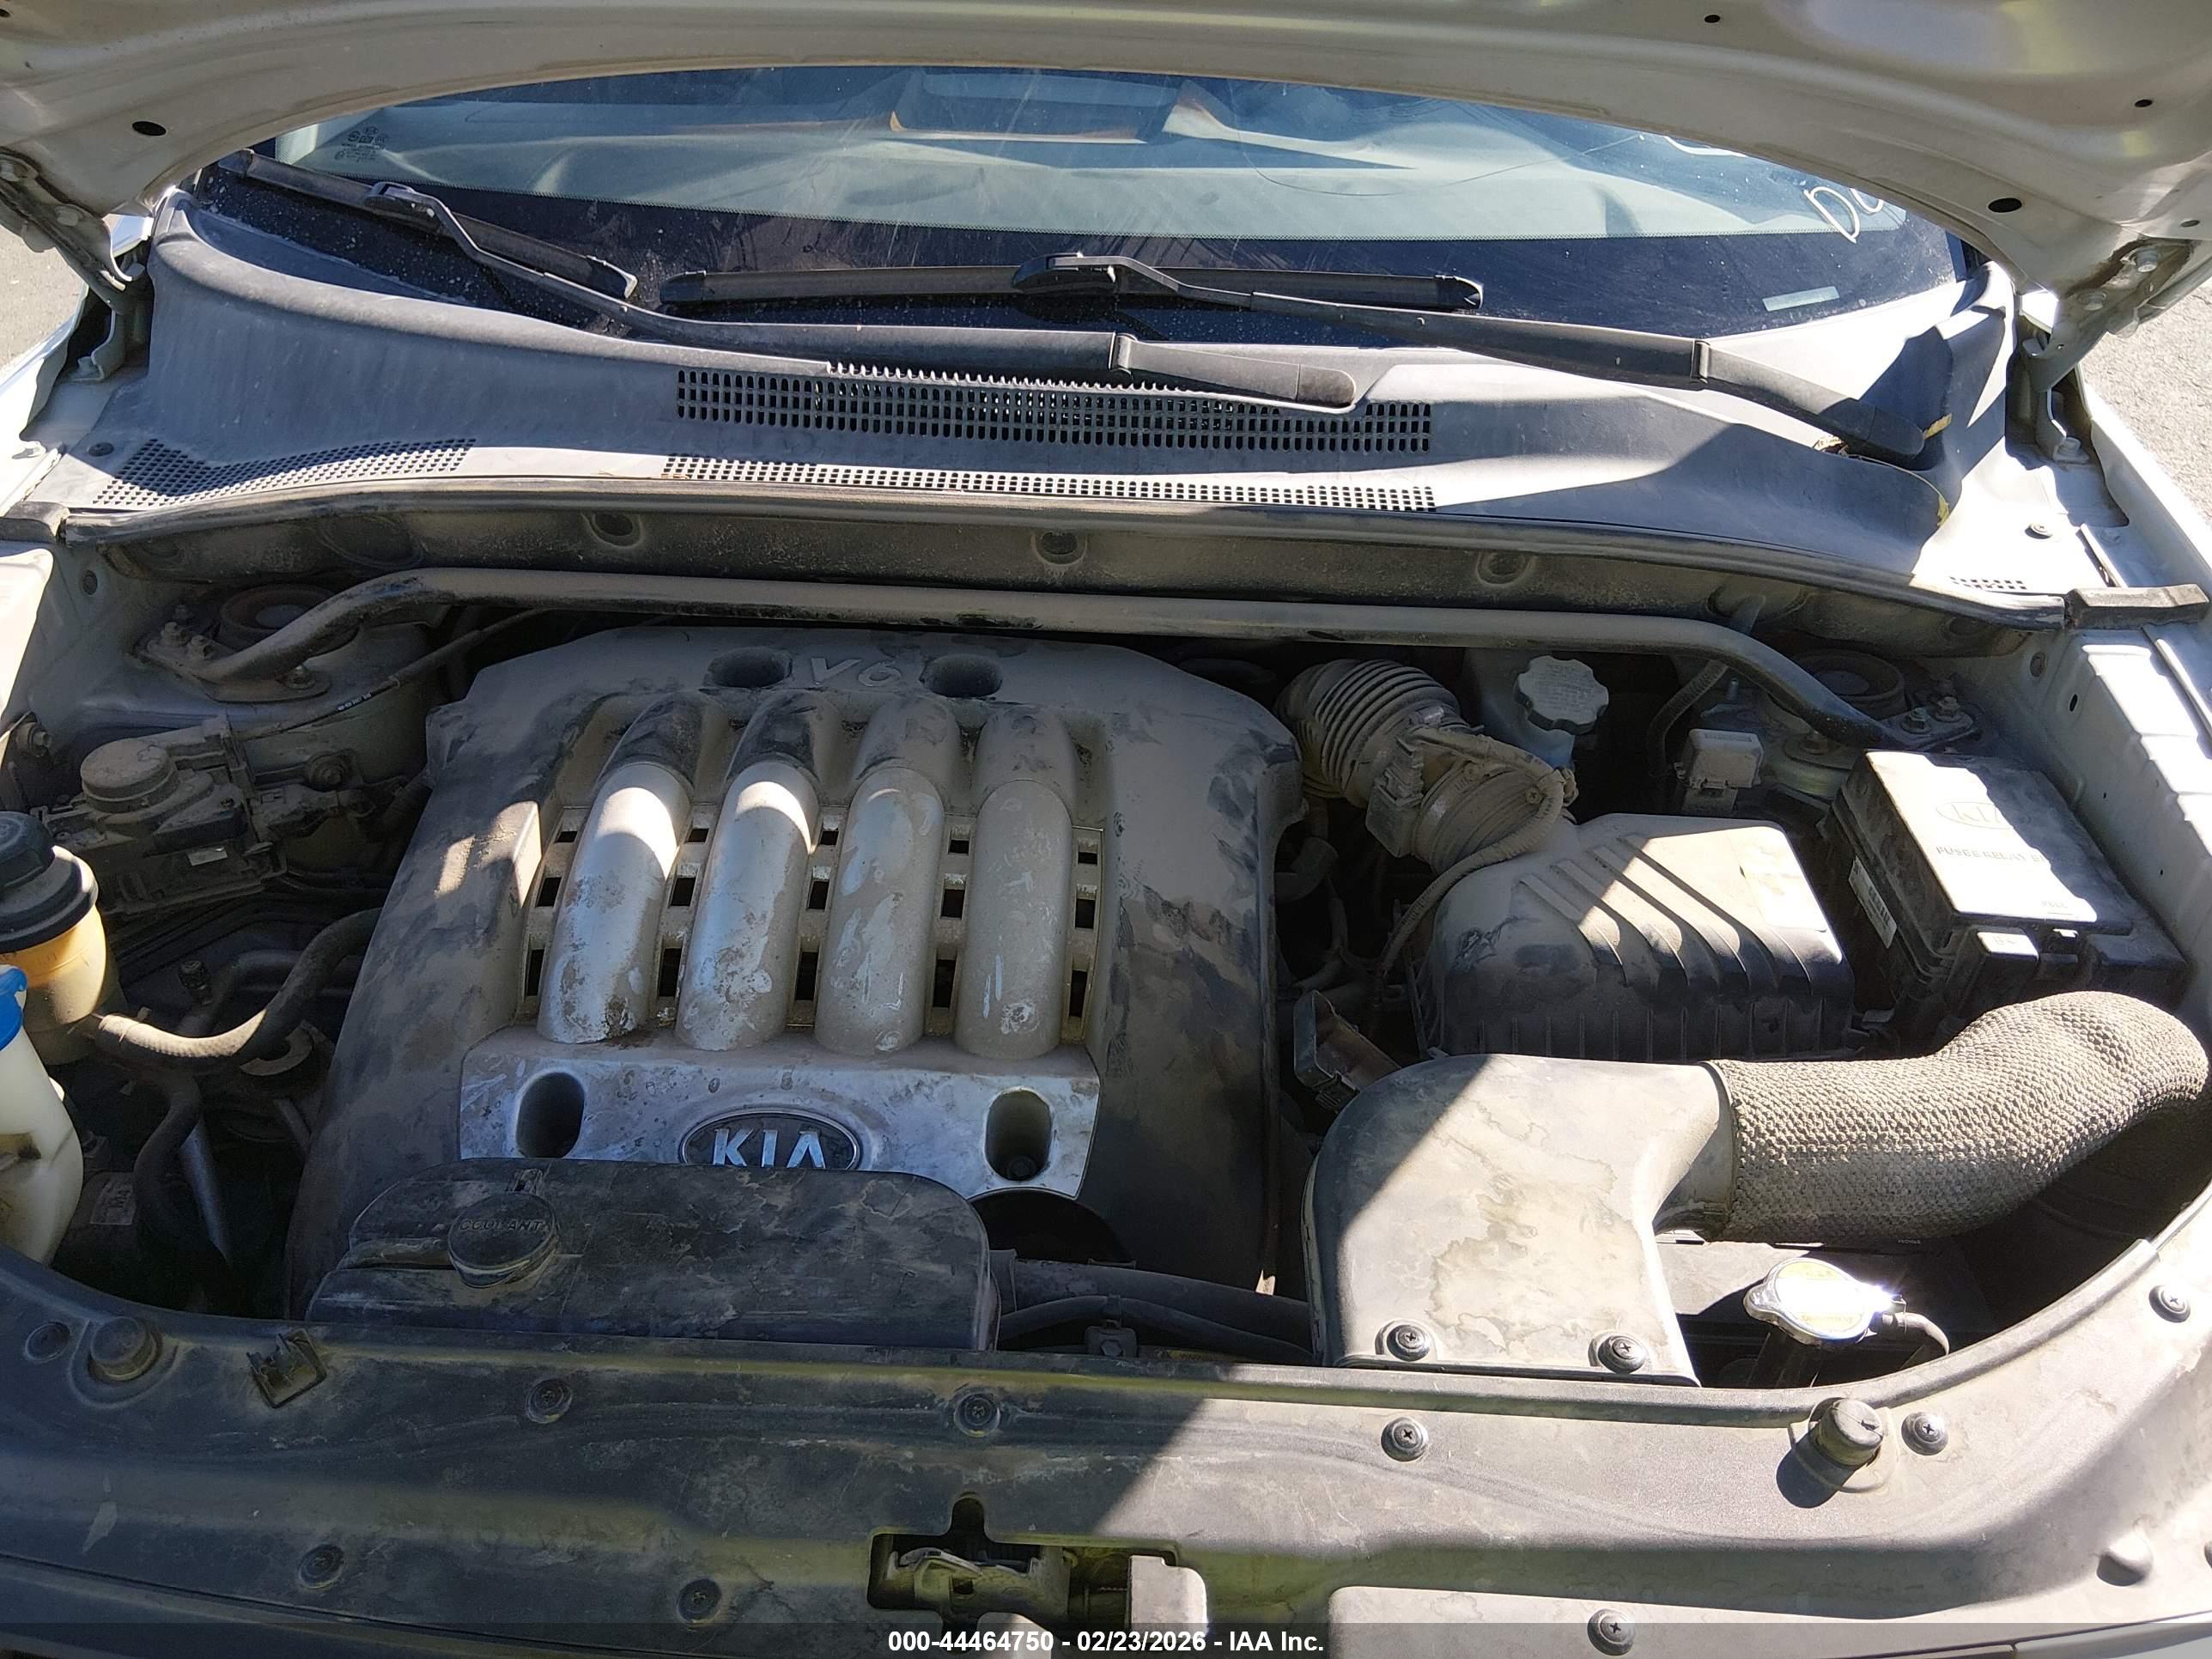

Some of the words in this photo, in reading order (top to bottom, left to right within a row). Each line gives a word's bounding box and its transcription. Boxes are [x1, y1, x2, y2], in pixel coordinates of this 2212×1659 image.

[811, 657, 902, 687] V6
[1982, 850, 2027, 861] RELAY
[713, 1128, 826, 1169] KIA
[459, 1218, 544, 1232] COOLANT
